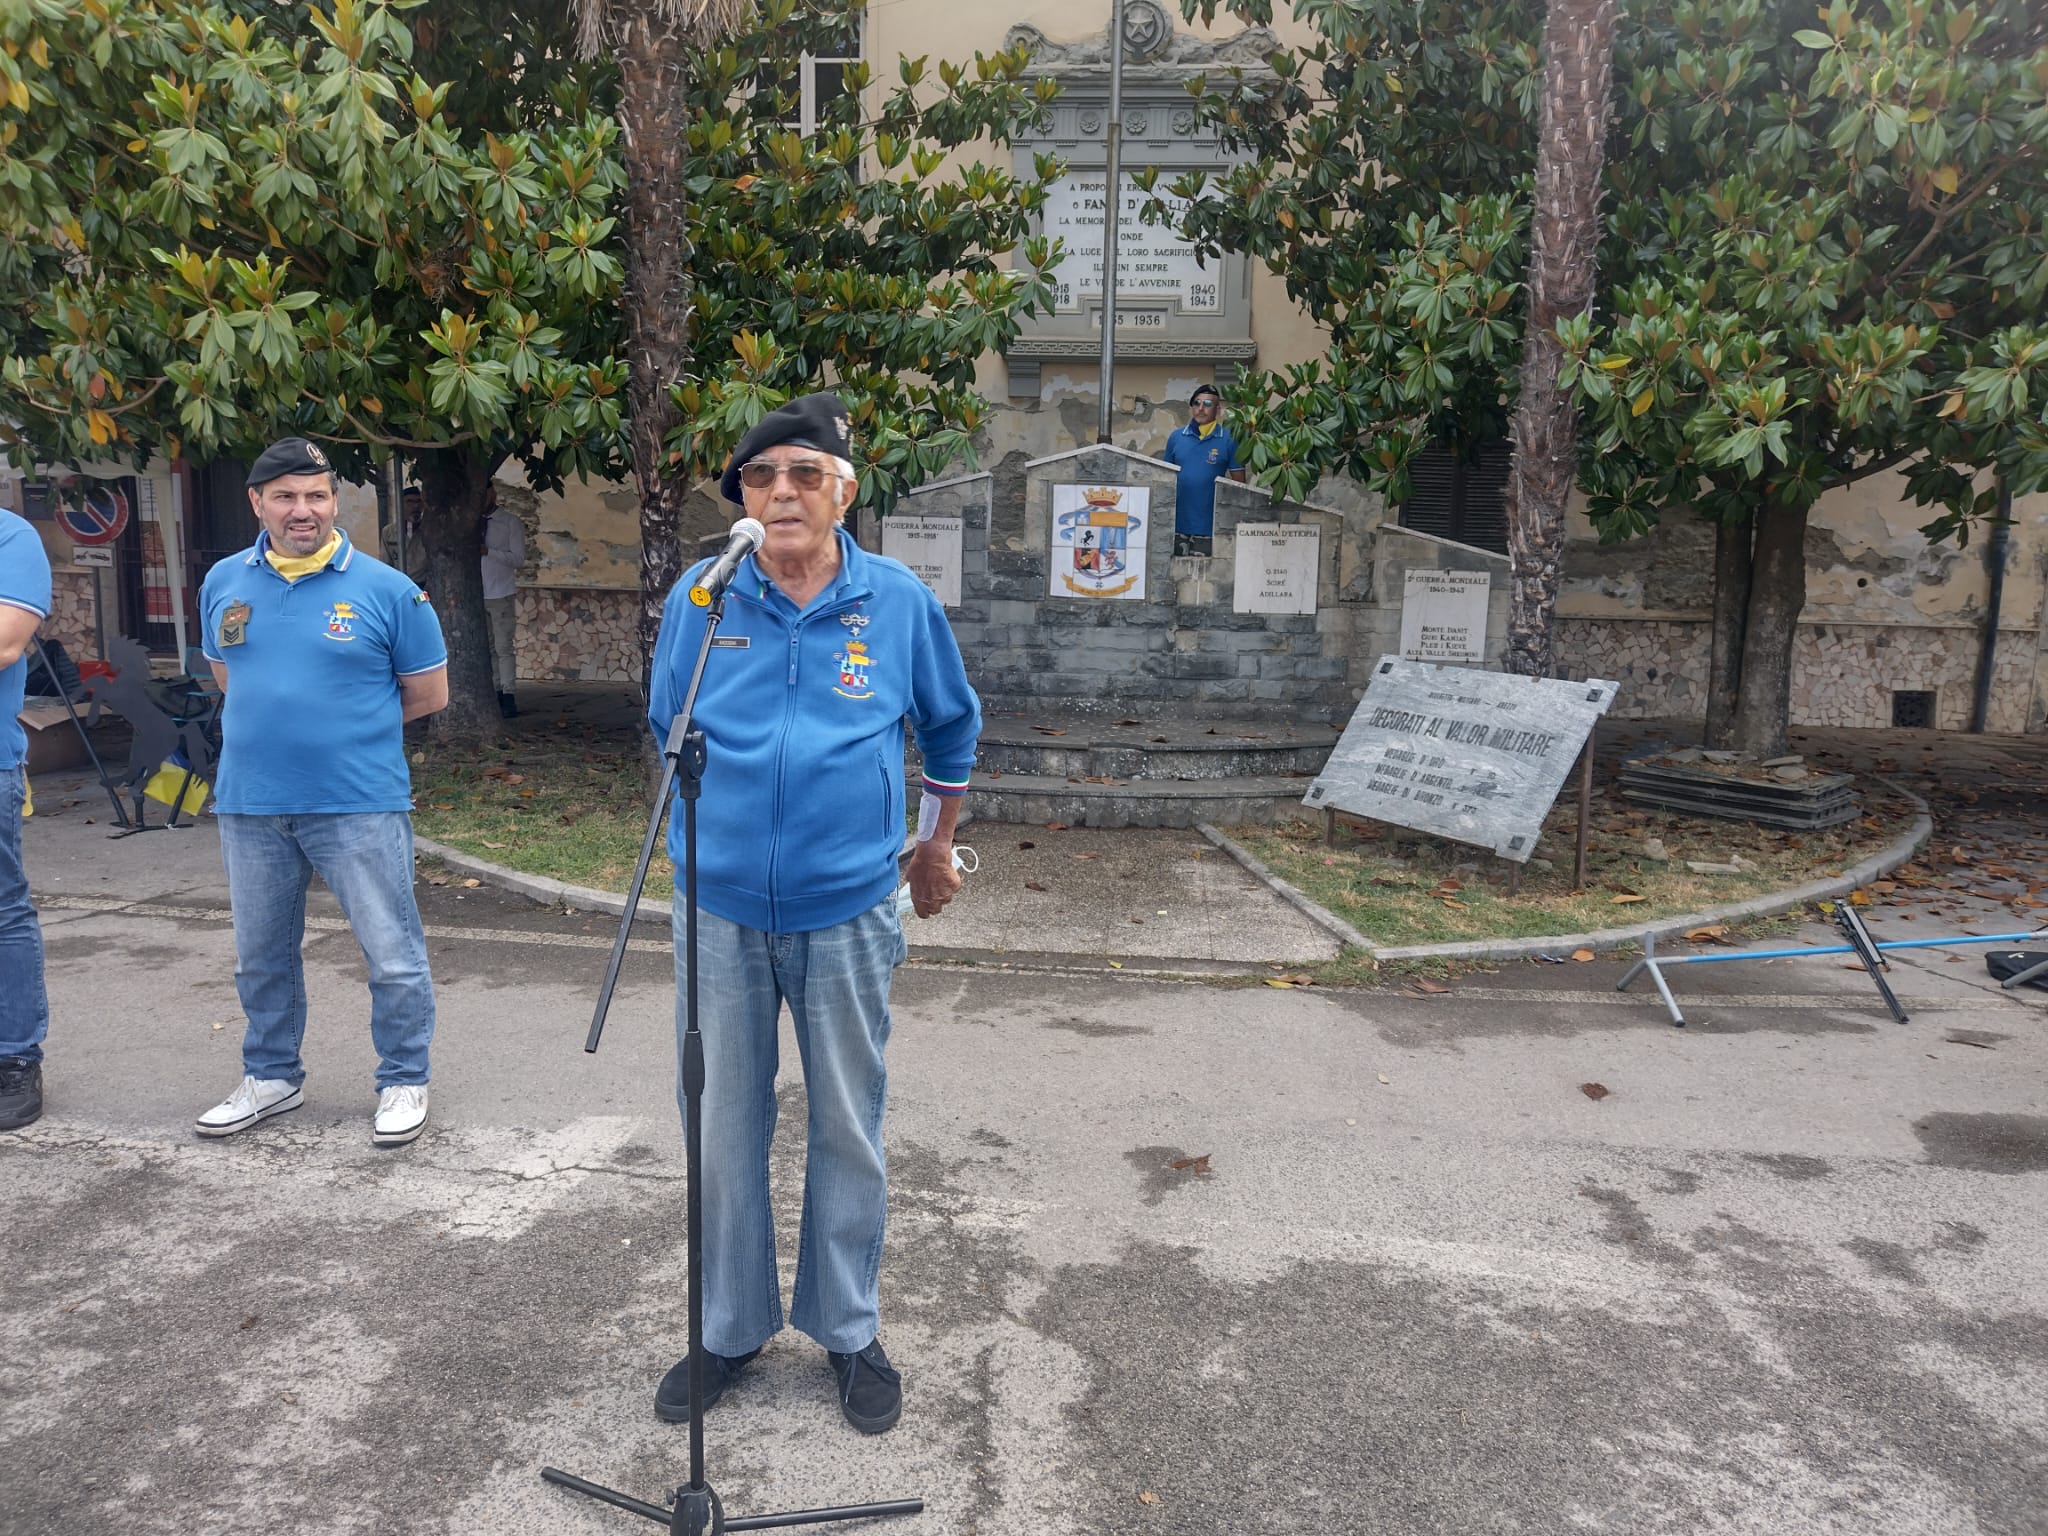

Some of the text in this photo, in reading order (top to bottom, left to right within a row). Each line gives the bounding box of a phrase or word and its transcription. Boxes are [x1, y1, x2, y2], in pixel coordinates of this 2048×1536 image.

[1059, 217, 1070, 225] LA
[1120, 233, 1144, 241] ONDE
[1080, 248, 1102, 256] LUCE
[1128, 248, 1149, 256] LORO
[1135, 264, 1168, 272] SEMPRE
[1080, 278, 1090, 286] LE
[1190, 284, 1216, 295] 1940
[1054, 295, 1216, 306] 918 1945
[1134, 315, 1160, 326] 1936
[890, 522, 919, 530] GUERRA
[922, 523, 960, 531] MONDIALE
[1416, 576, 1446, 584] GUERRA
[1368, 707, 1556, 758] DECORATI AL VALOR MILITARE
[1384, 747, 1417, 764] MEDAGLIE
[1374, 763, 1409, 780] MEDAGLIE
[1366, 778, 1399, 796] MEDAGLIE
